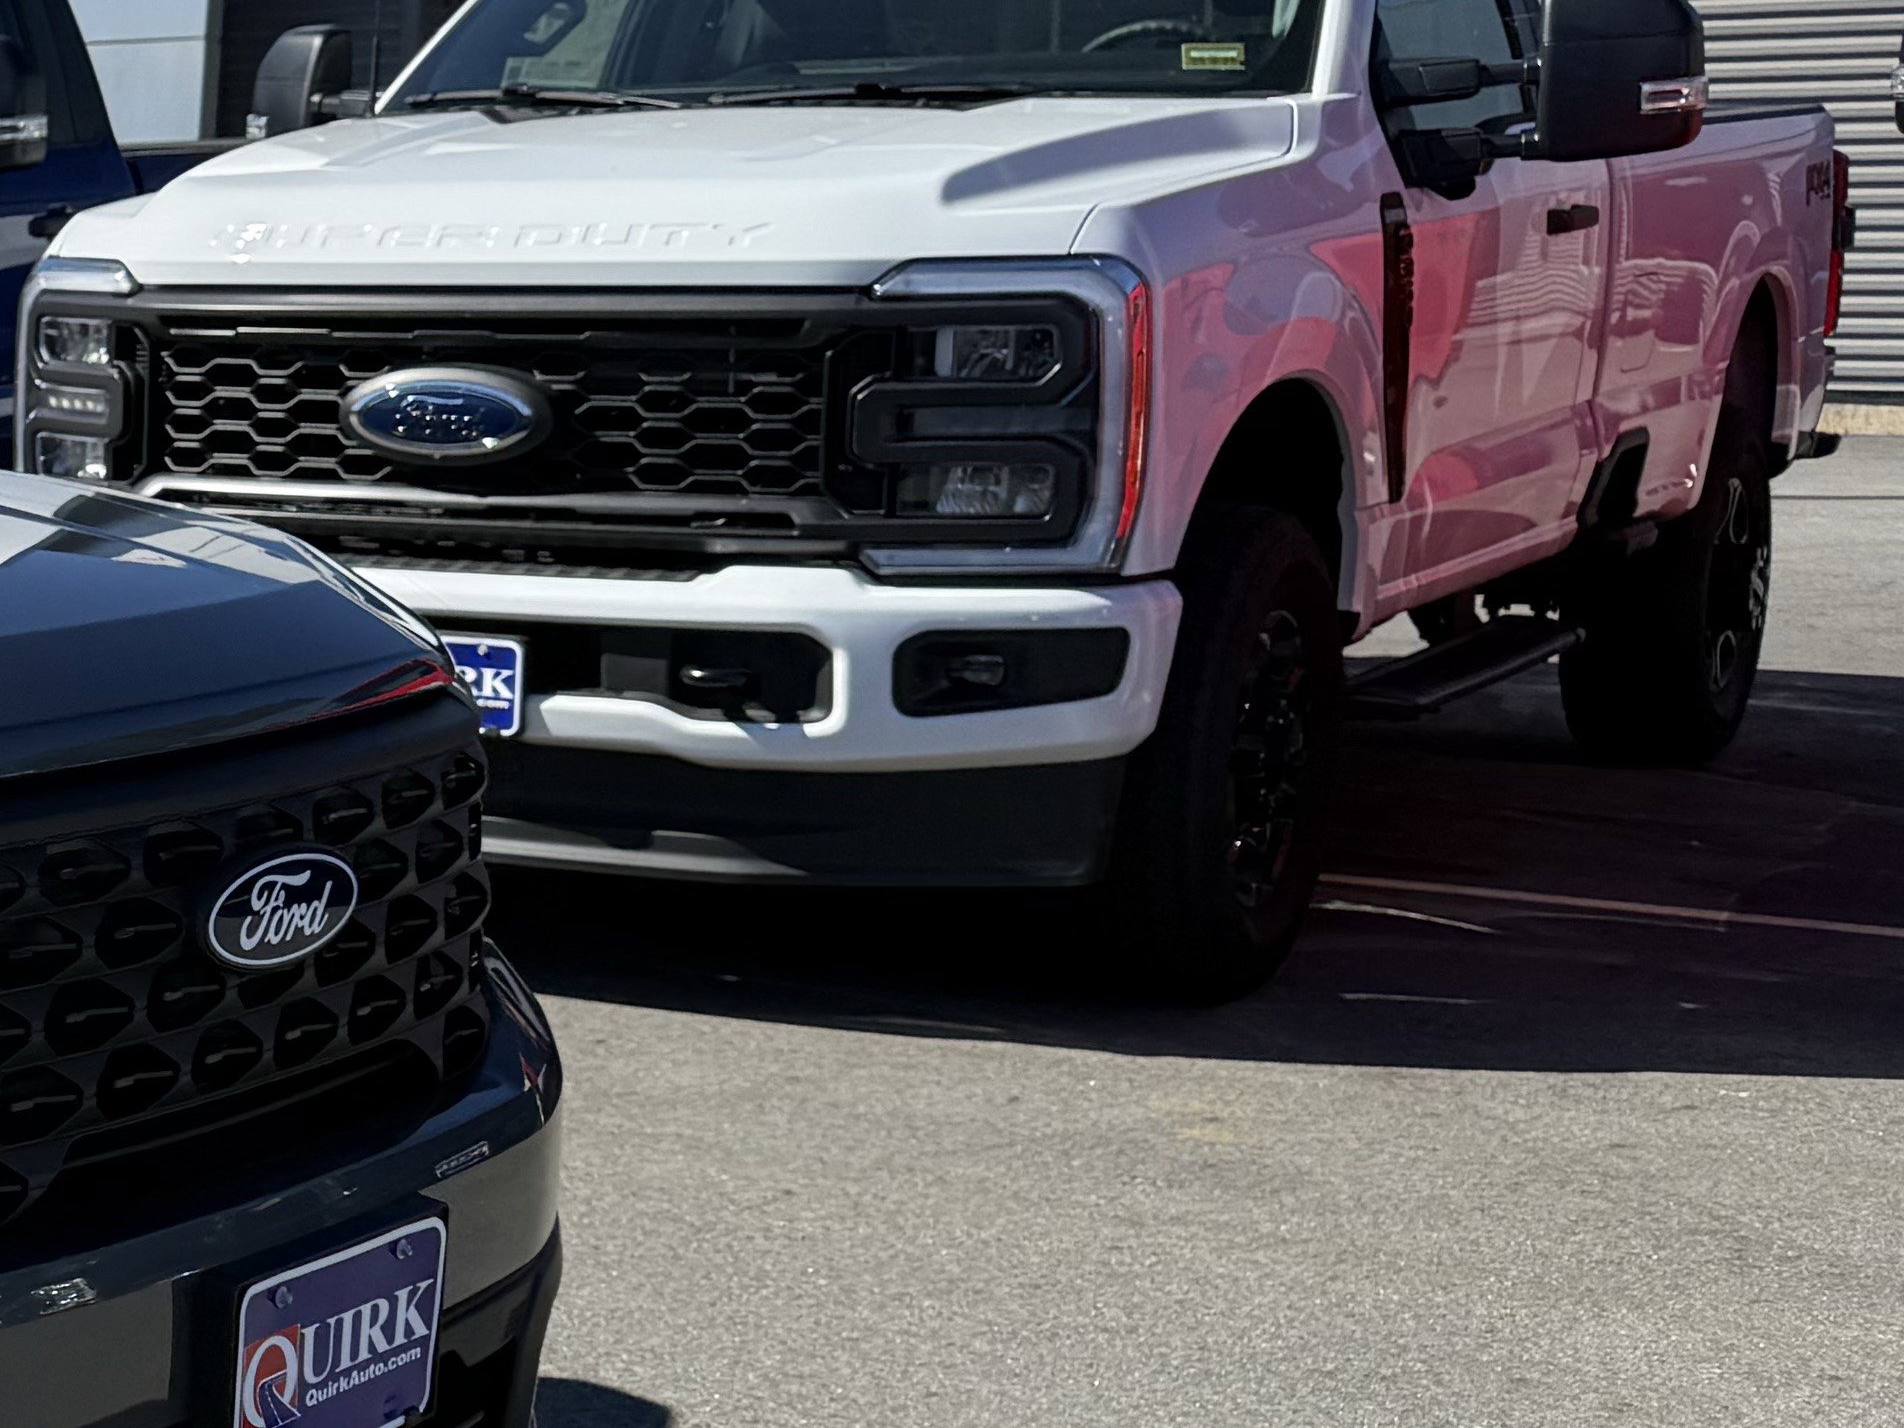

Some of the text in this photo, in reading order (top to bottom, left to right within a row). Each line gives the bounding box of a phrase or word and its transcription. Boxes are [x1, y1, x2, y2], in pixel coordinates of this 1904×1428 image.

[209, 222, 500, 251] UPER
[240, 870, 333, 951] Ford
[305, 1346, 422, 1408] QuirkAuto.com
